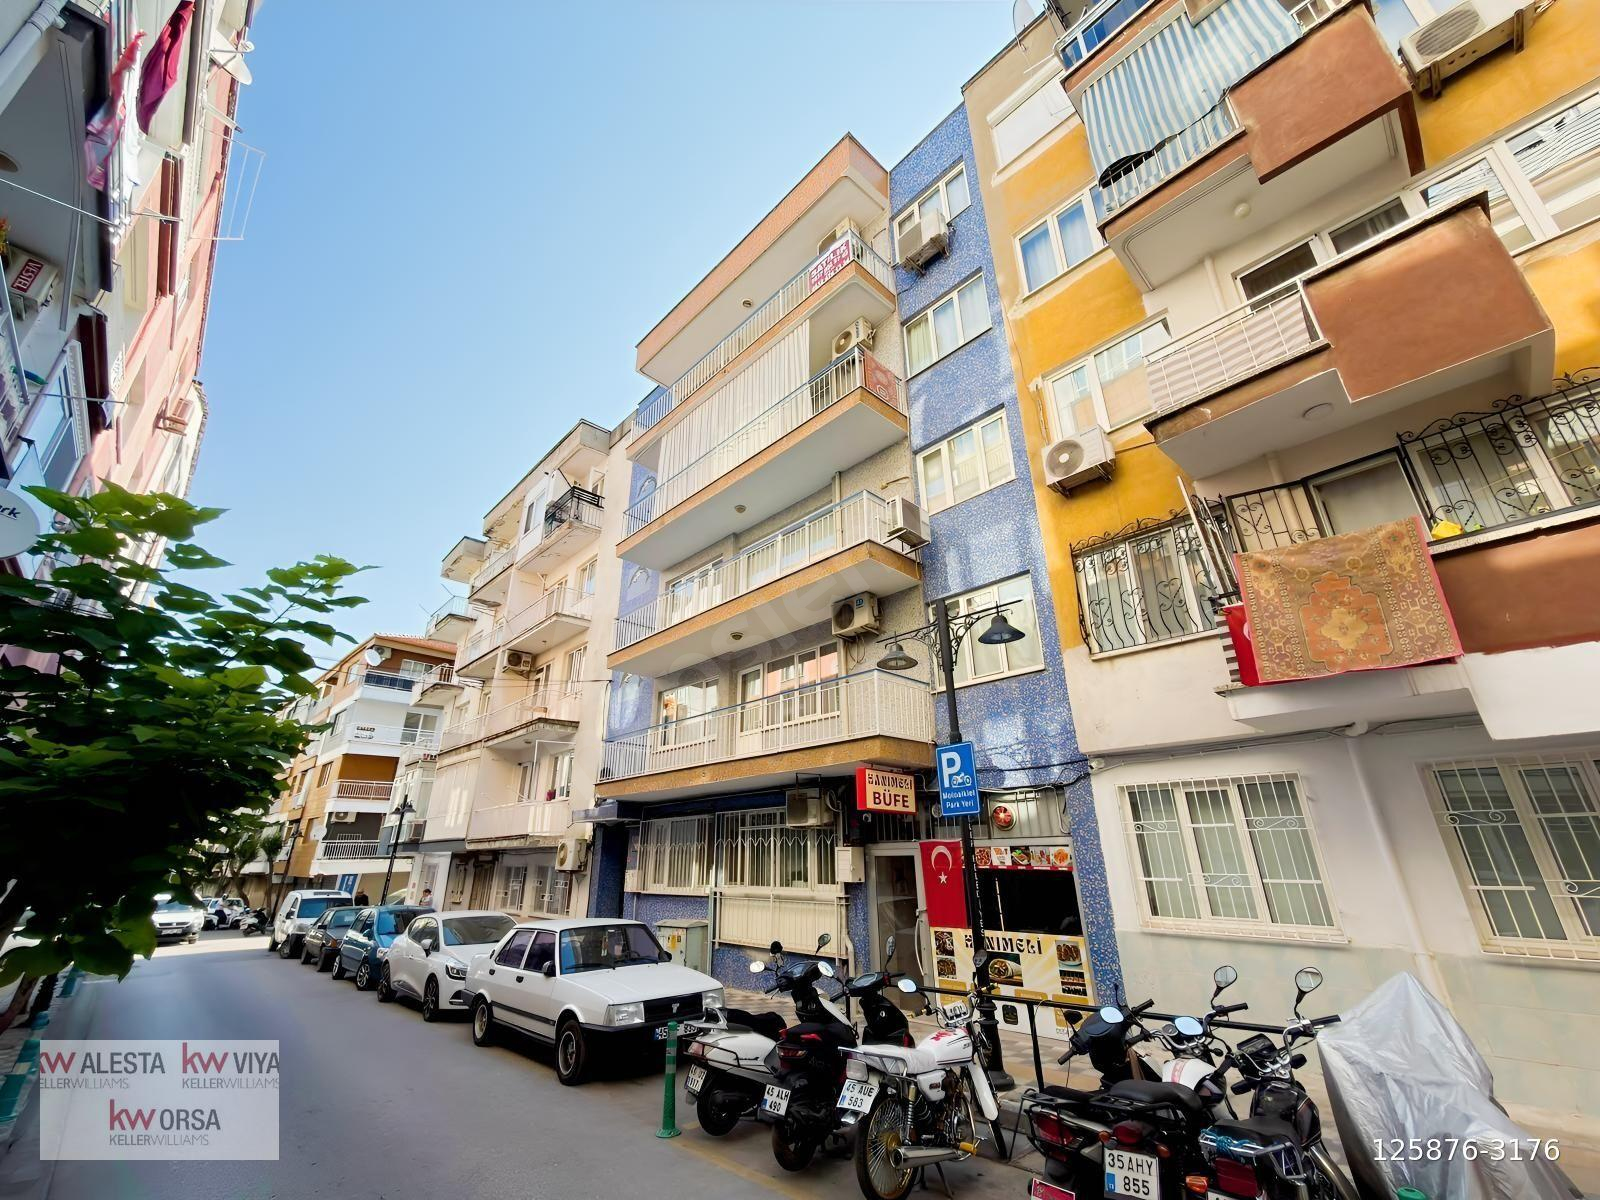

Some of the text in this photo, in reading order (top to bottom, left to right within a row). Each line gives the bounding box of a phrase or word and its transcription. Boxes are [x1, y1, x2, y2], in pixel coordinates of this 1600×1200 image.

[12, 261, 42, 289] VESTEL
[941, 752, 961, 788] P
[873, 789, 910, 808] BÜFE
[946, 801, 960, 809] Park
[964, 934, 1043, 954] HNIMELİ
[858, 1085, 875, 1098] AUE
[769, 1100, 782, 1113] 490
[848, 1096, 864, 1108] 583
[1123, 1175, 1150, 1196] 855
